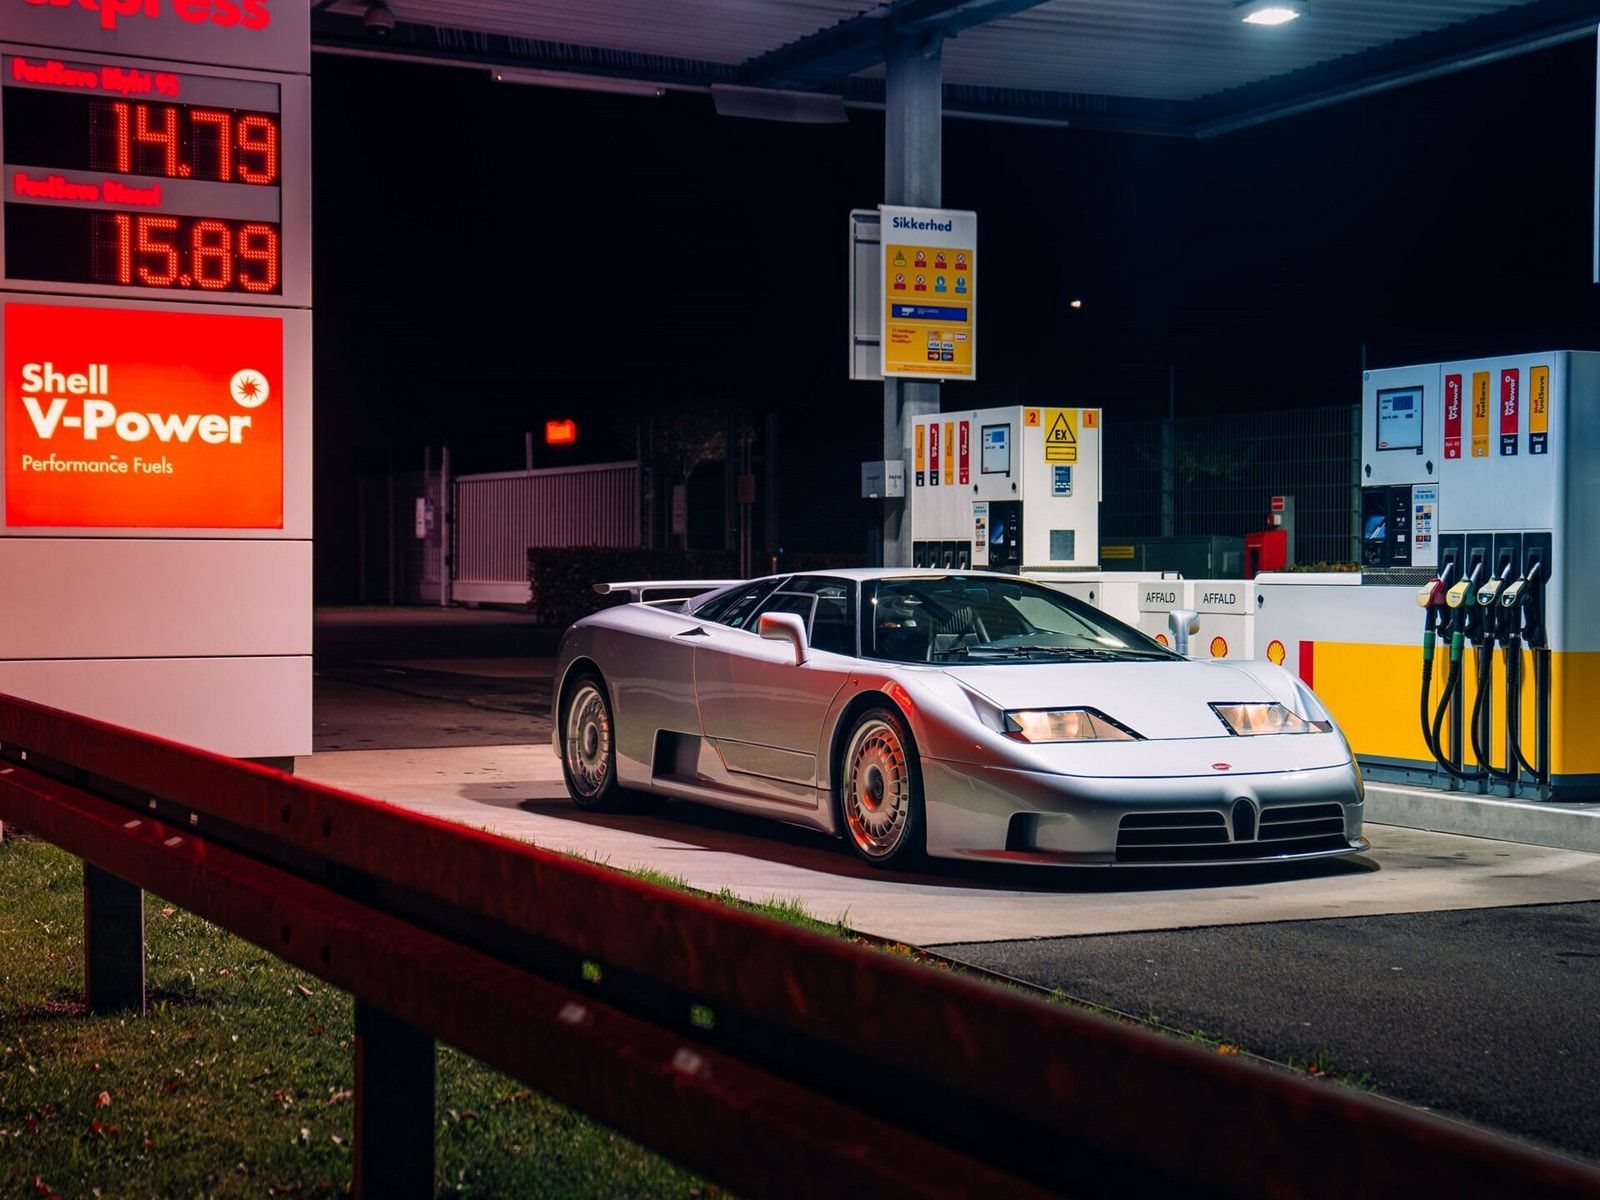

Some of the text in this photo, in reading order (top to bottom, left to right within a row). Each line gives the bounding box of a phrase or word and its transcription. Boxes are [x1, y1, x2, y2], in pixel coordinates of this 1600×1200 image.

[113, 103, 277, 184] 14.79
[892, 216, 952, 232] Sikkerhed
[114, 214, 278, 291] 15.89
[21, 362, 108, 395] Shell
[22, 397, 252, 444] V-Power
[1029, 412, 1036, 423] 2
[1088, 413, 1092, 424] 1
[1055, 429, 1067, 440] EX
[22, 453, 173, 474] Performance Fuels
[1146, 592, 1176, 604] AFFALD
[1203, 593, 1236, 605] AFFALD
